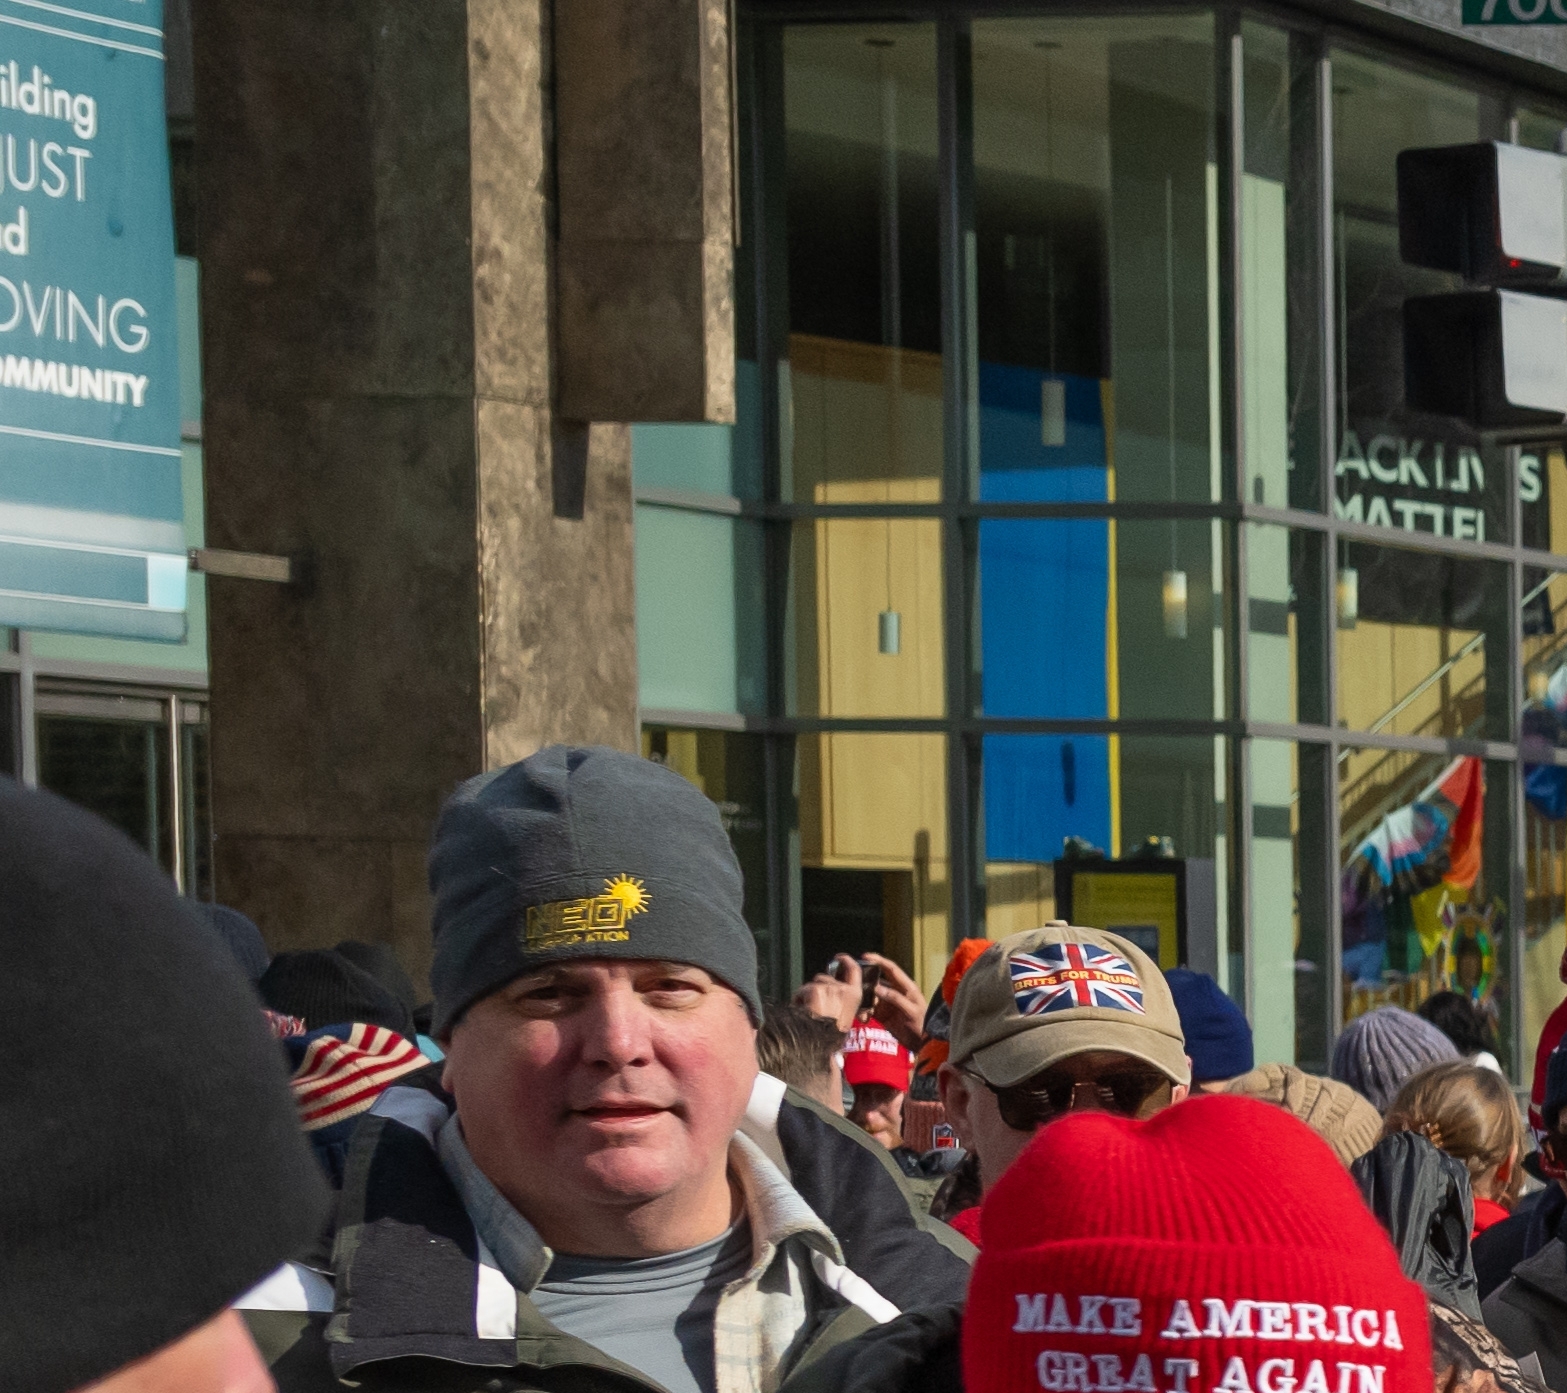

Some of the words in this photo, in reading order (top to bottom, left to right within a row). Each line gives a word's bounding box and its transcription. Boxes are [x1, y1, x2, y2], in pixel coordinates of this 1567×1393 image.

[1014, 976, 1057, 991] BRITS
[1060, 970, 1090, 981] FOR
[1093, 970, 1139, 987] TRUMP
[1012, 1293, 1142, 1336] MAKE
[1160, 1298, 1403, 1351] AMERICA
